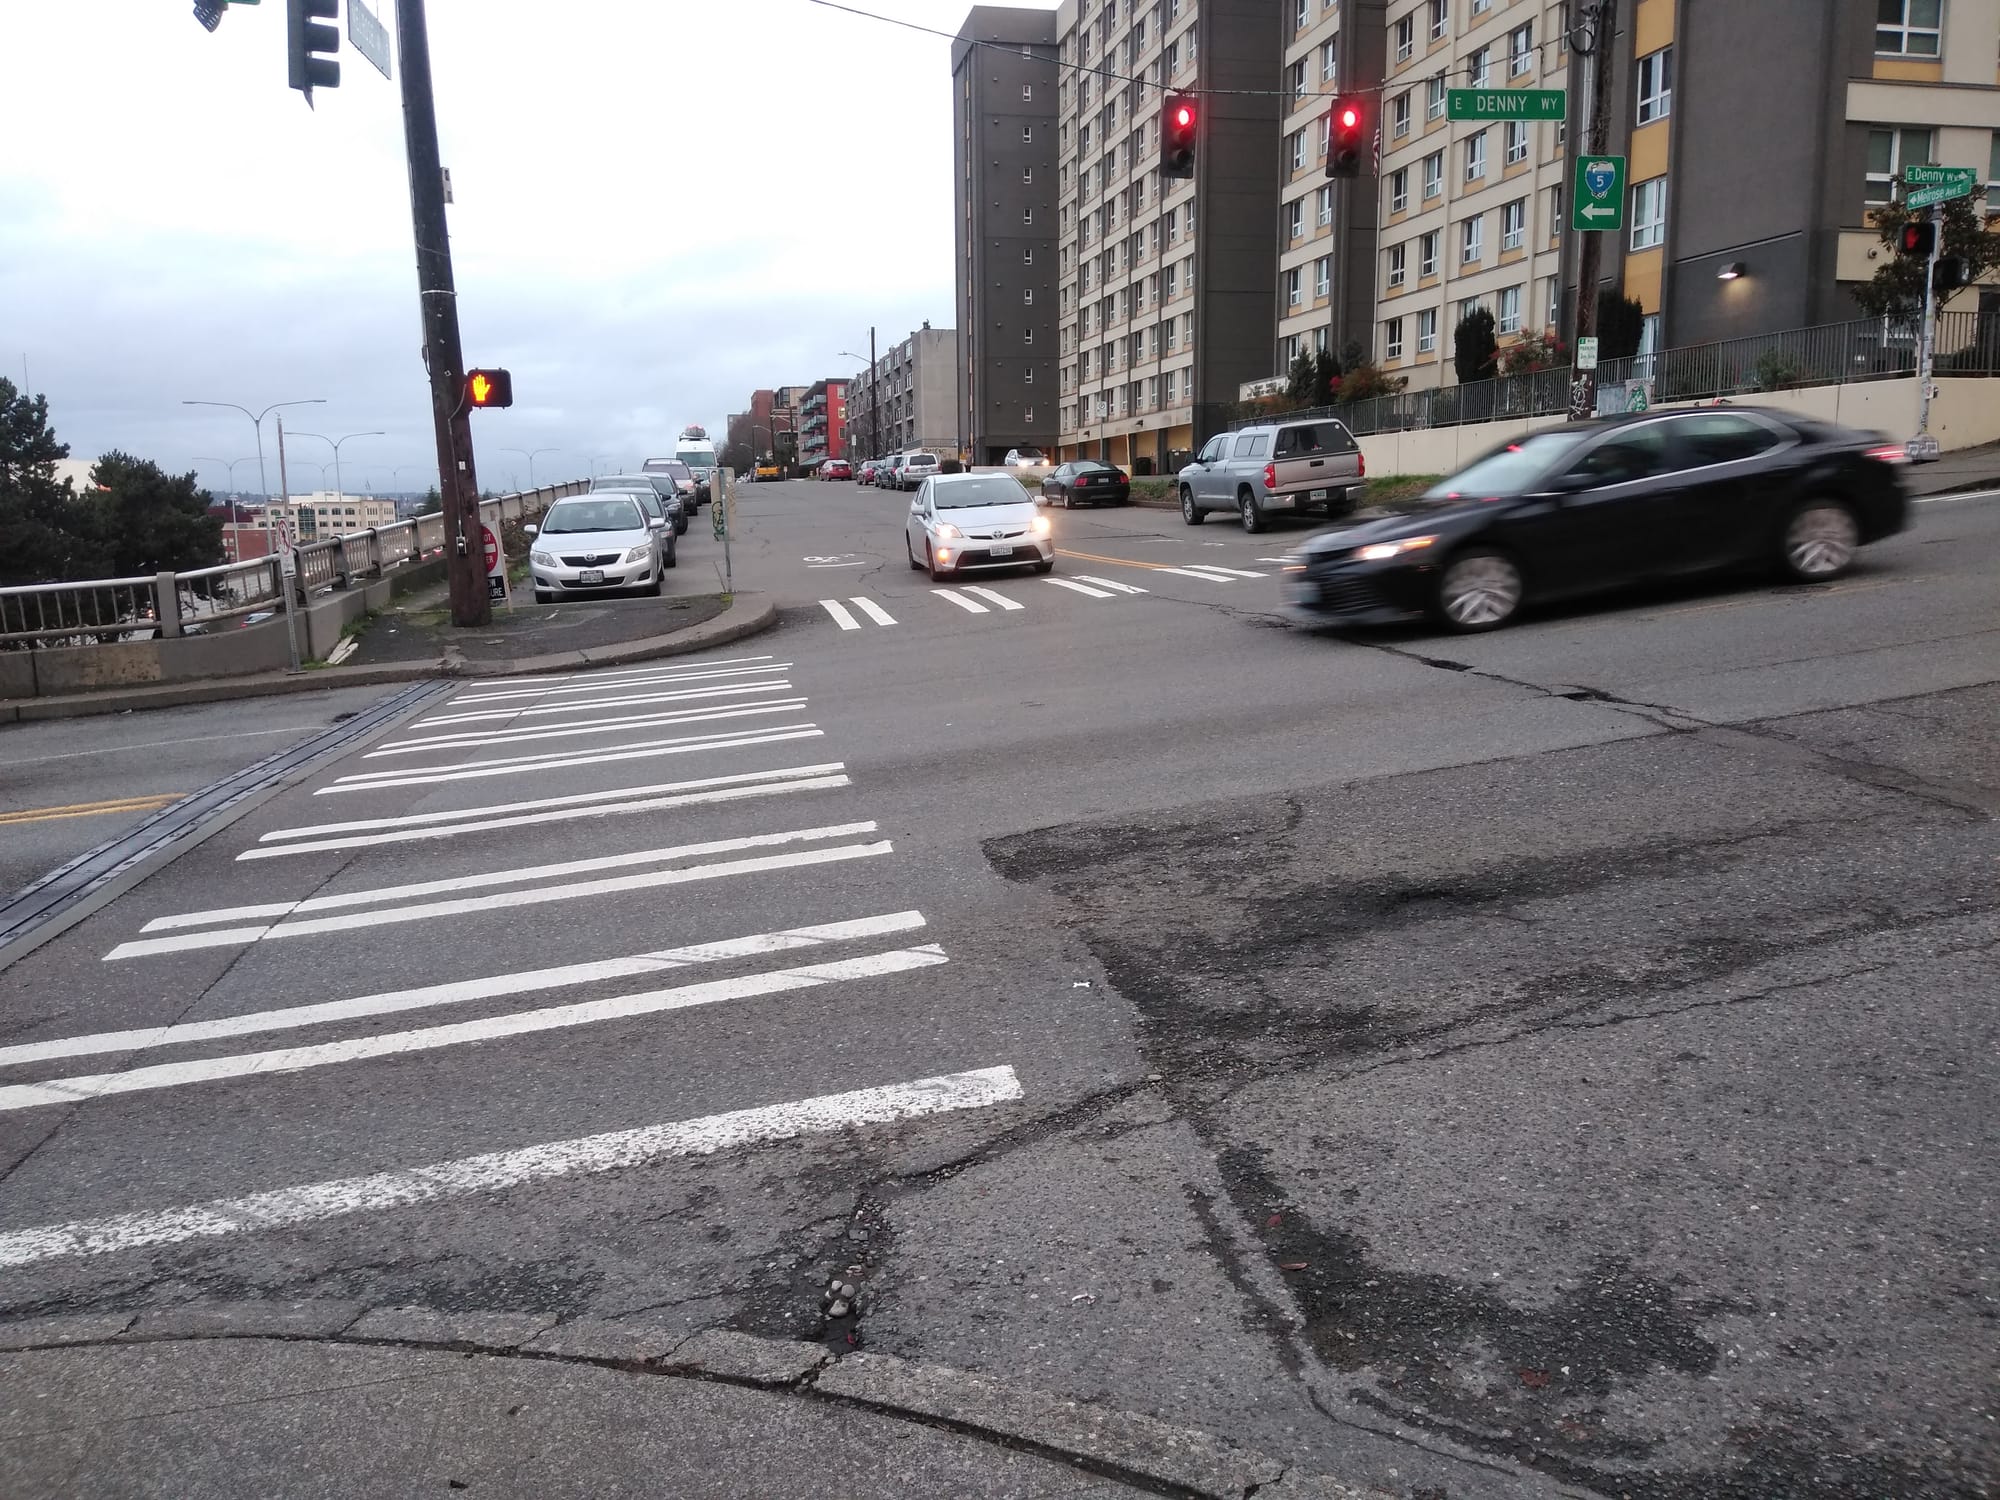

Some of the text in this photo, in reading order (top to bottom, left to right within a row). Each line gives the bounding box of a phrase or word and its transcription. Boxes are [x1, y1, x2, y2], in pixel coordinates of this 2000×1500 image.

[1455, 95, 1558, 112] E DENNY WY
[1596, 175, 1604, 187] 5
[1908, 171, 1912, 180] E
[1915, 168, 1944, 183] Denny
